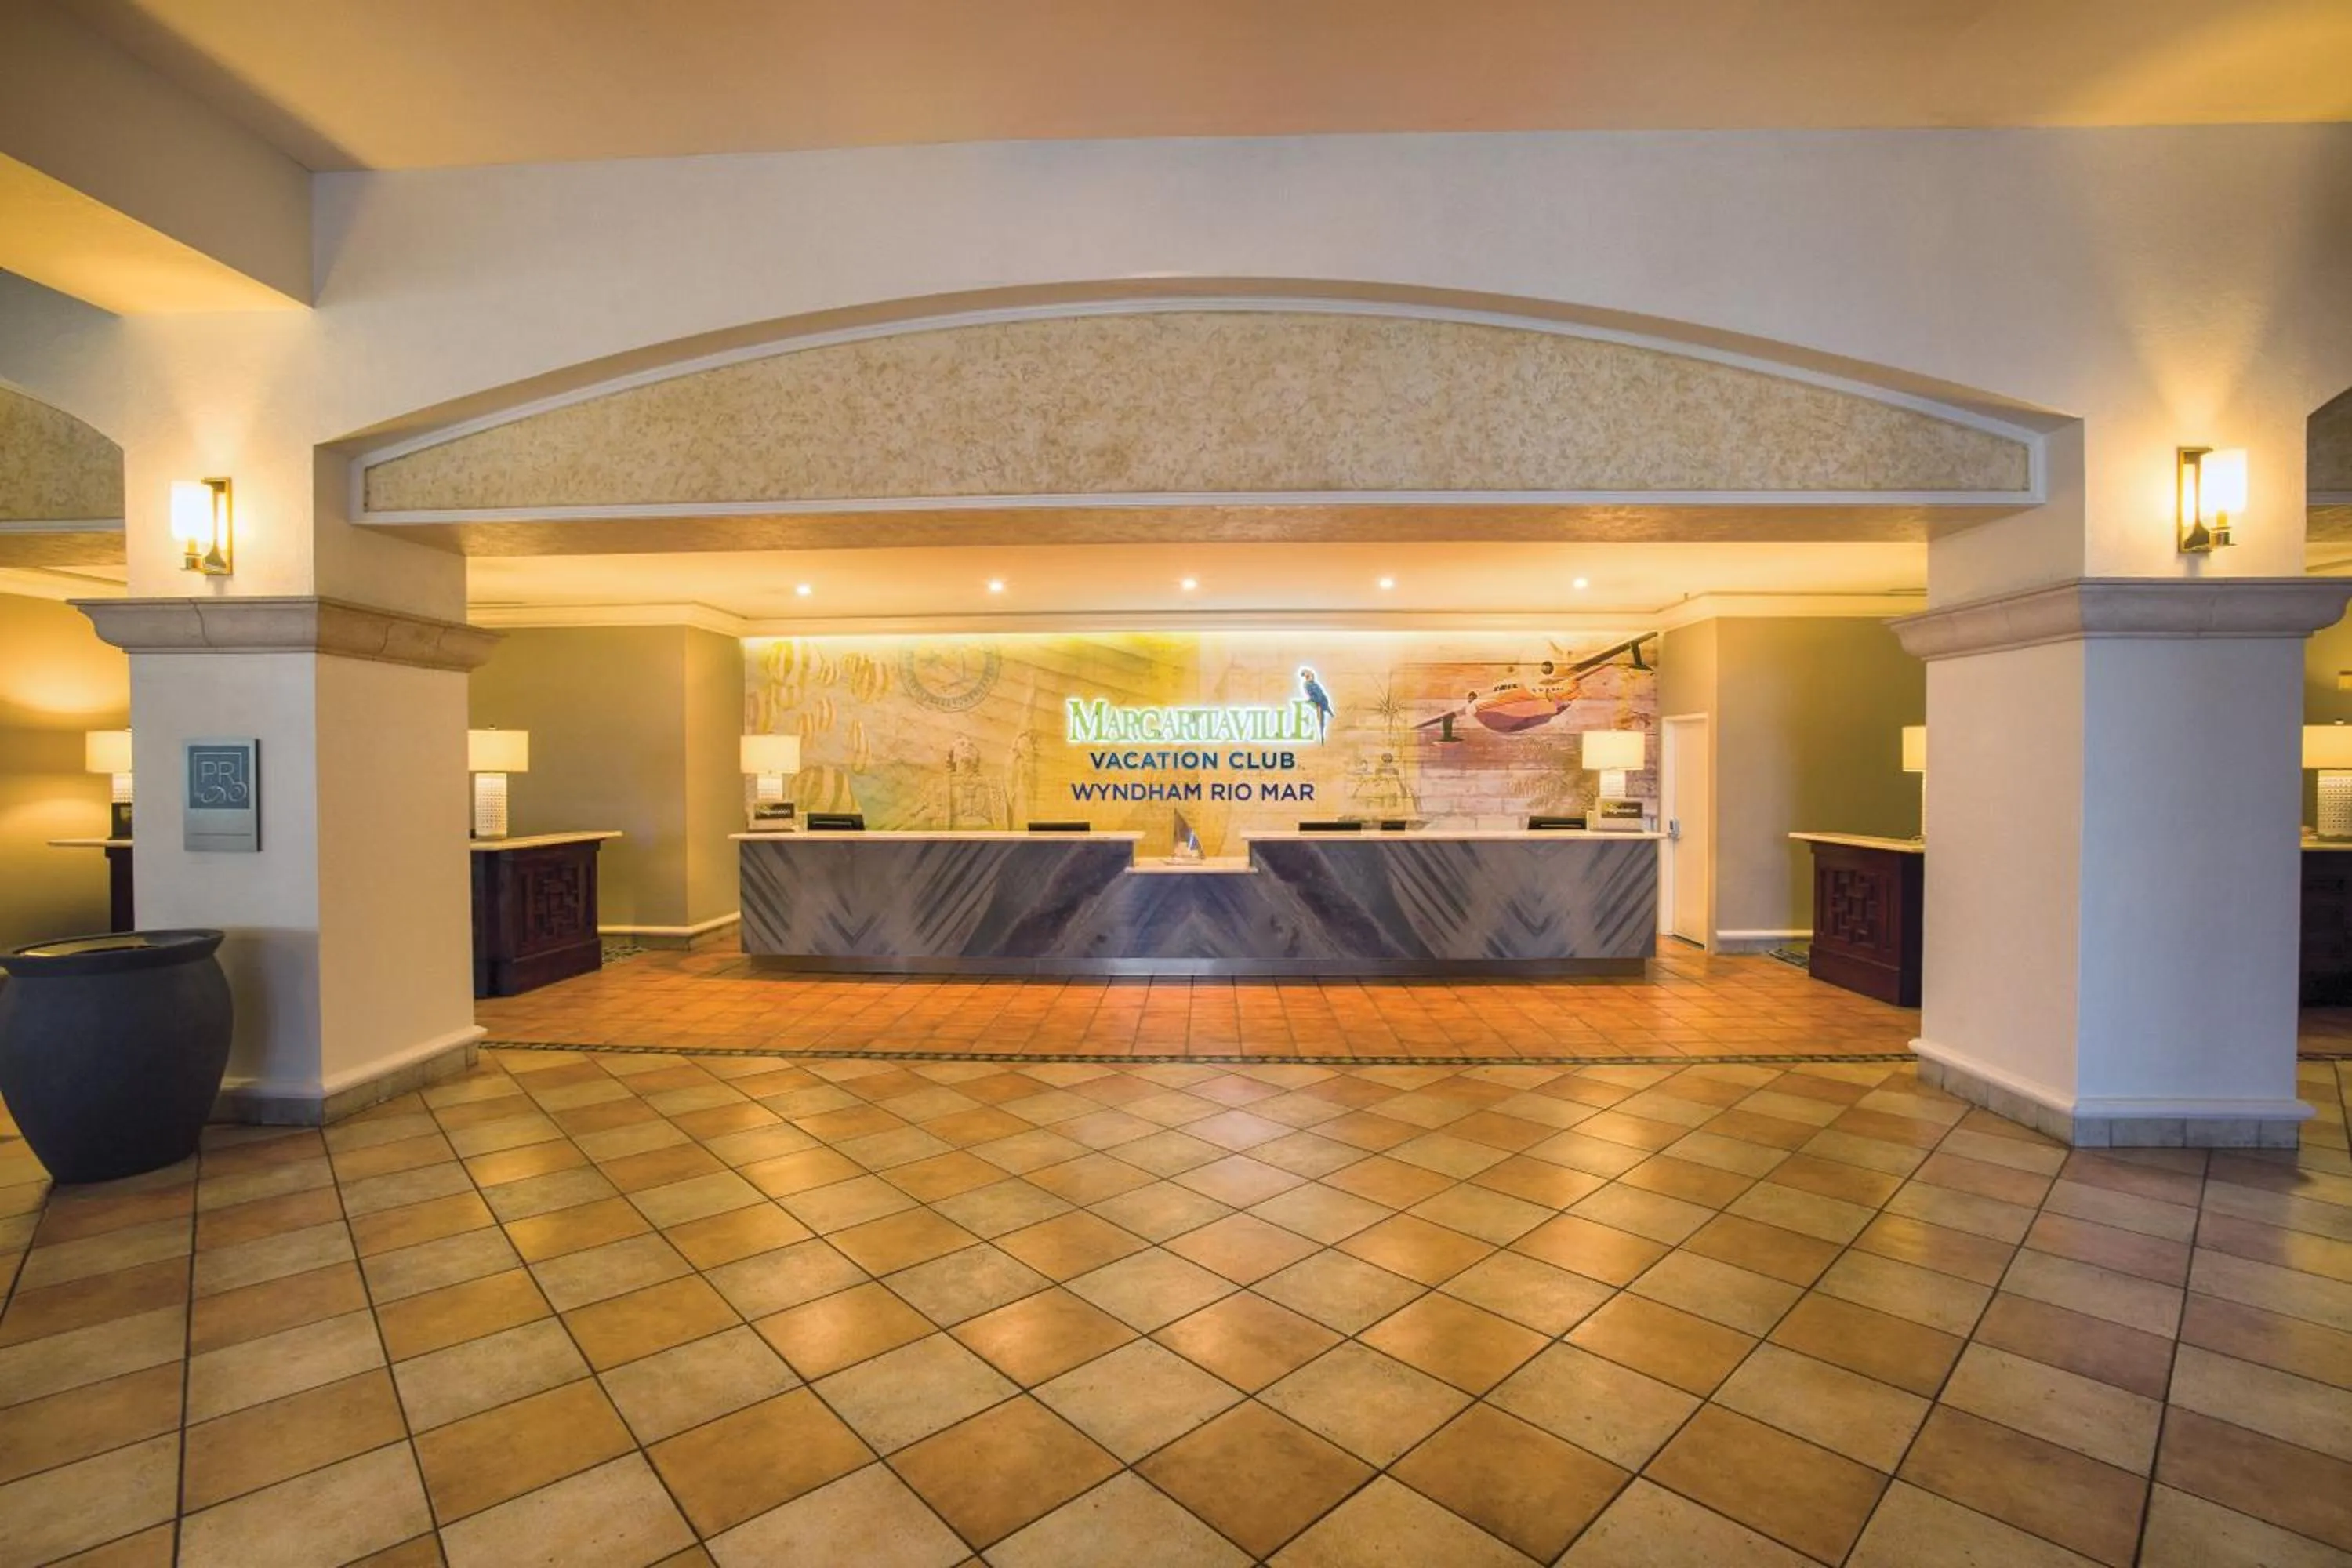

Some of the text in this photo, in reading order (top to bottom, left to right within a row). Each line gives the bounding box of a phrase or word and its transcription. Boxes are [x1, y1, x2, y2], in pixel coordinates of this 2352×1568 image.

[1069, 701, 1316, 741] MARGARITAVILLE
[1091, 752, 1296, 769] VACATION CLUB
[1072, 783, 1315, 800] WYNDHAM RIO MAR
